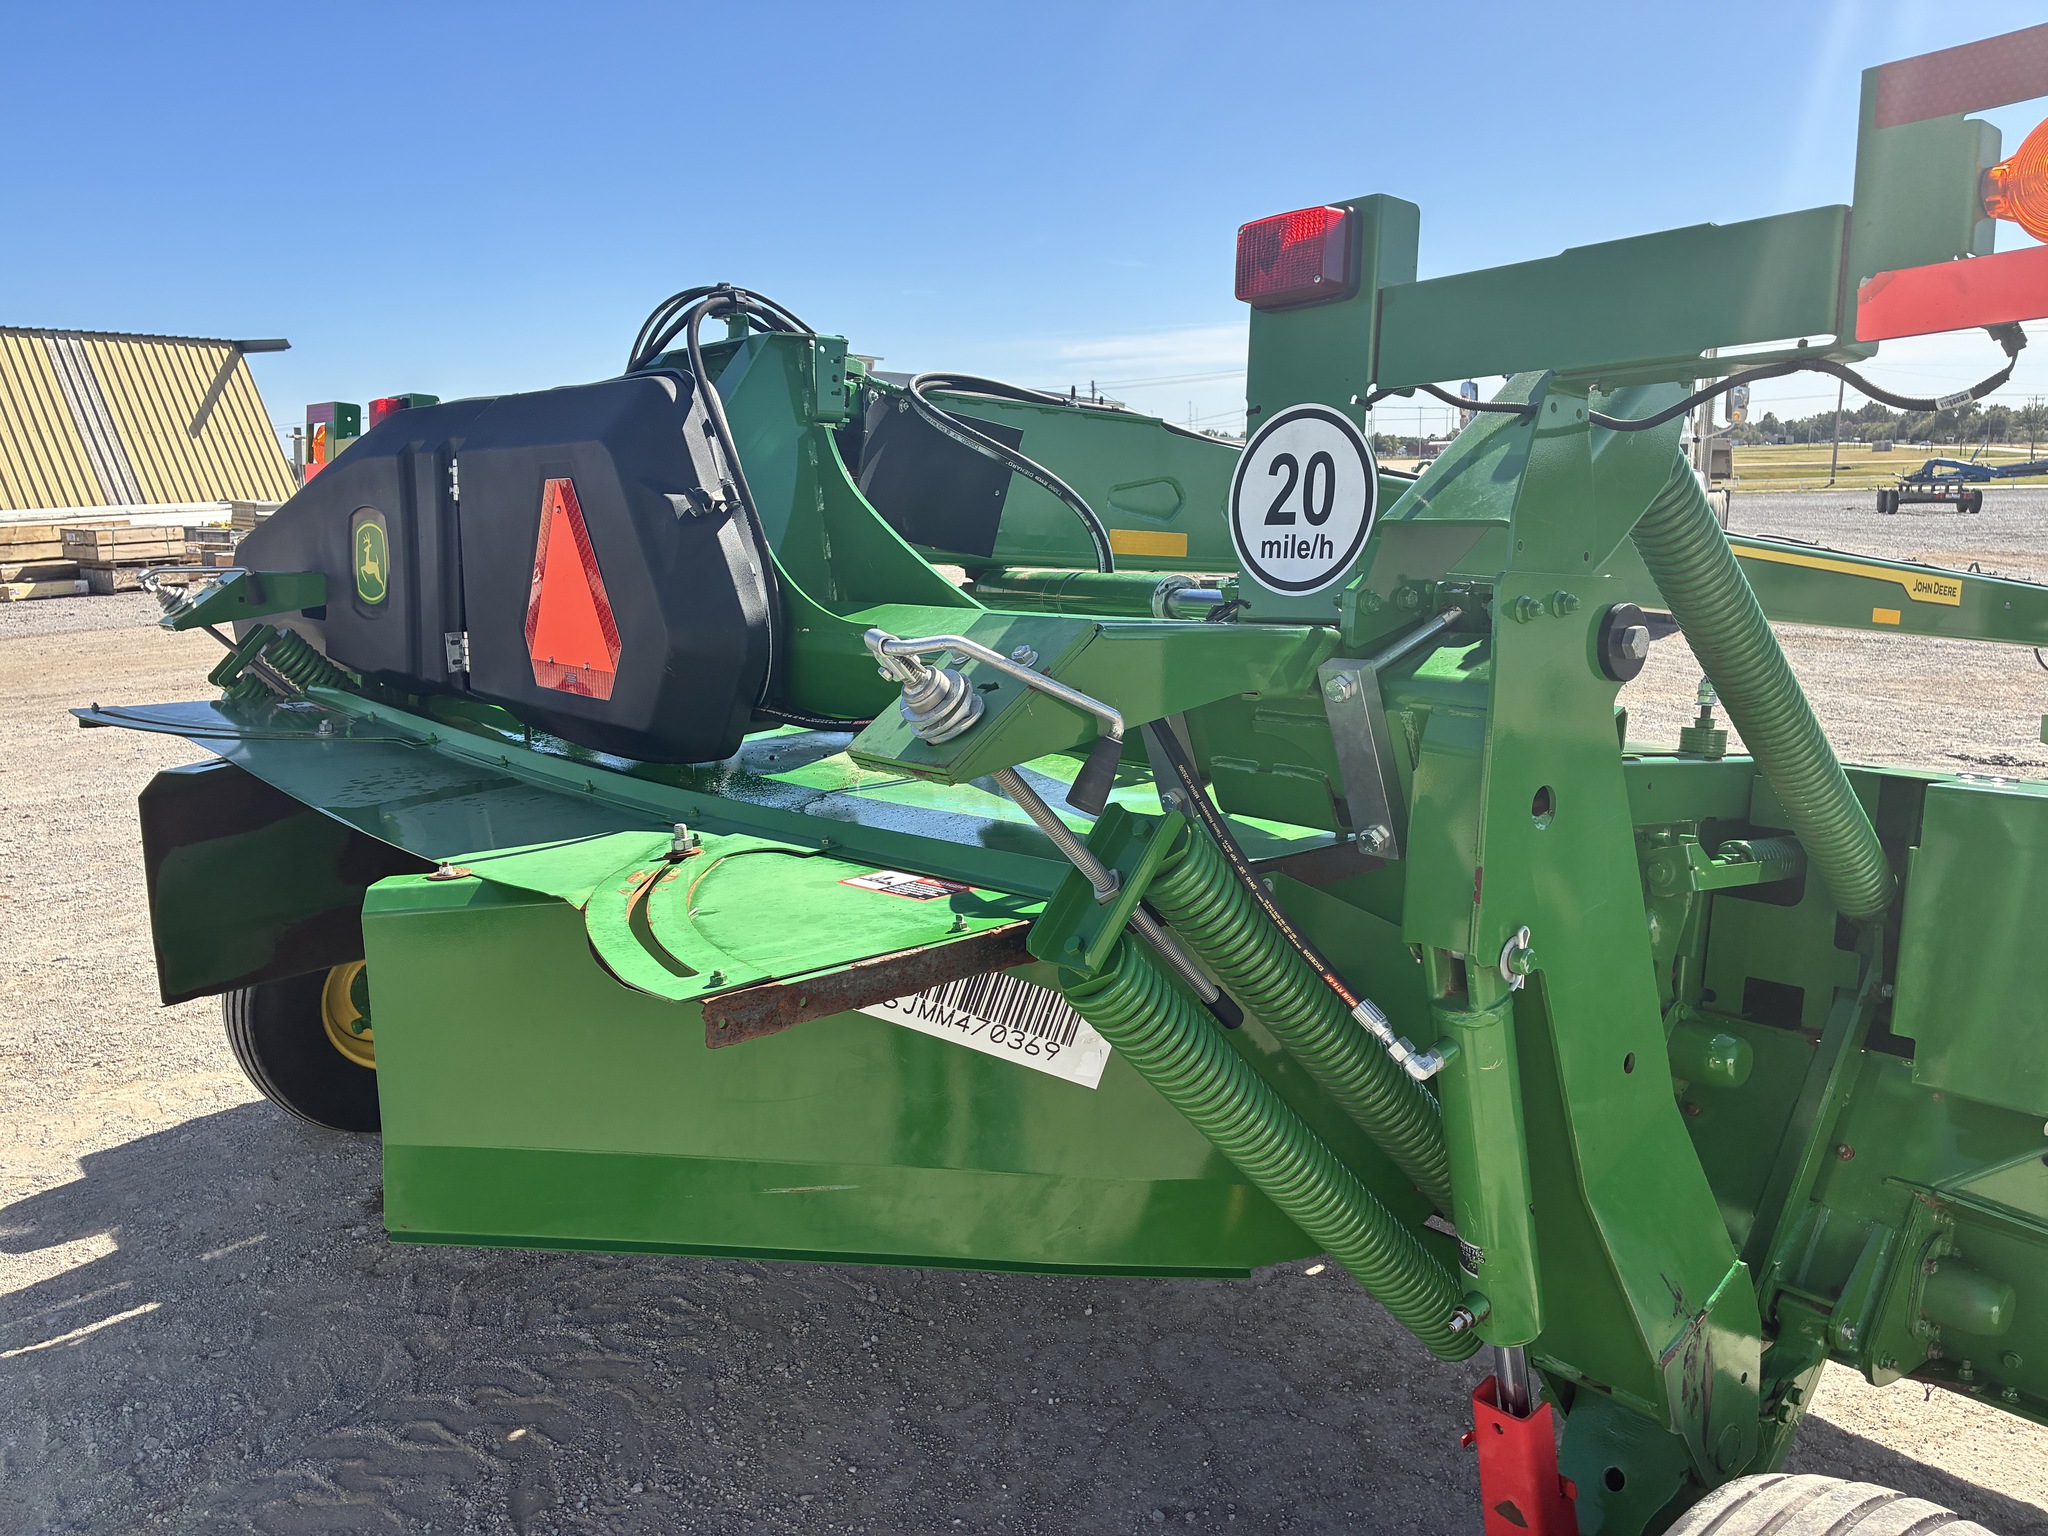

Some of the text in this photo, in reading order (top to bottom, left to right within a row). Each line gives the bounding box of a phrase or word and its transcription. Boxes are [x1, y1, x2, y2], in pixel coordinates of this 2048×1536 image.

[1264, 451, 1335, 526] 20
[1261, 533, 1334, 560] mile/h
[1913, 579, 1957, 598] JOHN DEERE
[1244, 875, 1258, 890] DN10
[1301, 948, 1324, 971] EXCEEDS
